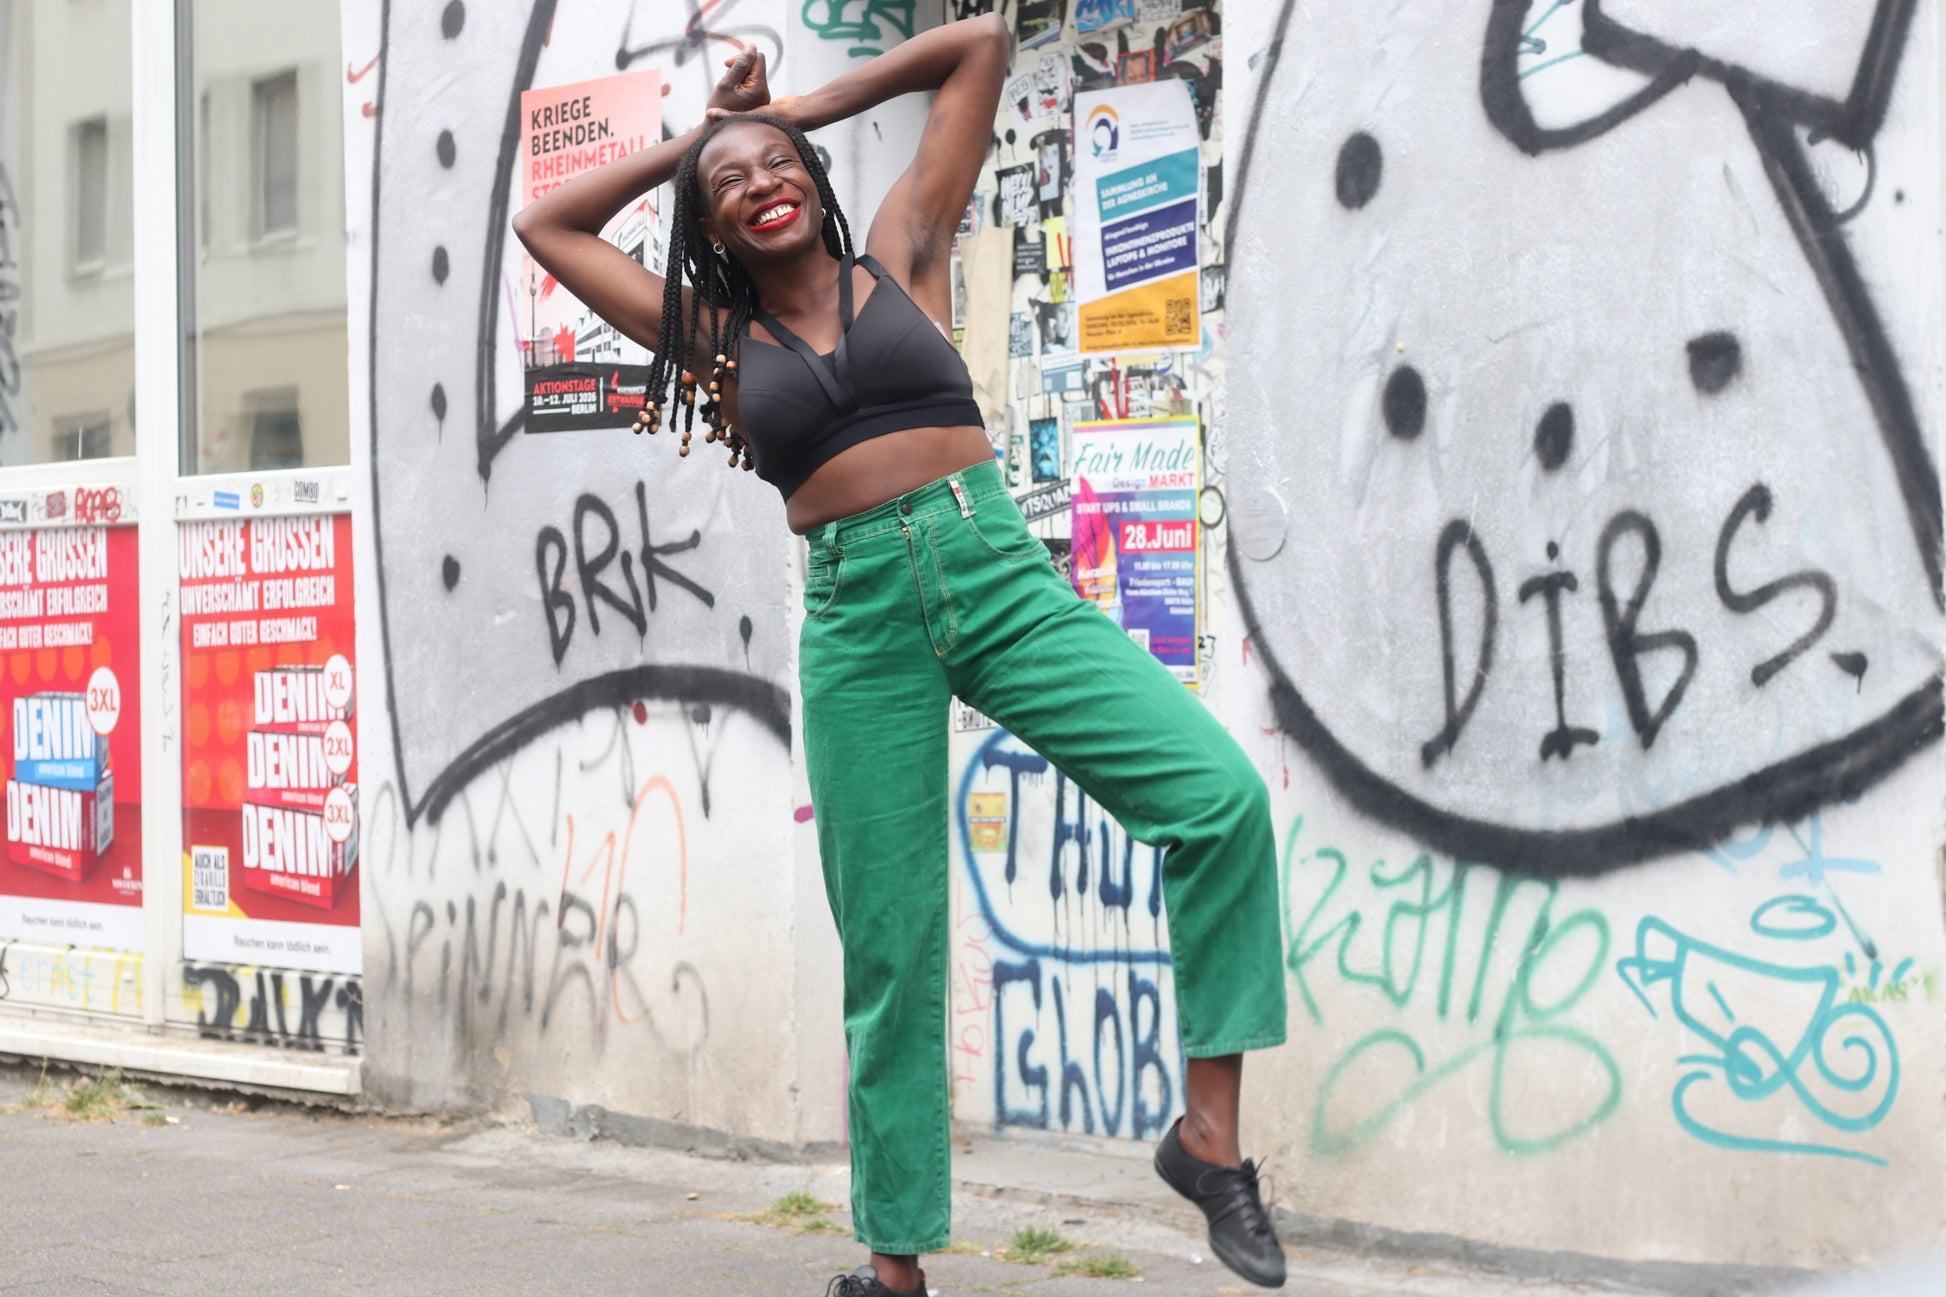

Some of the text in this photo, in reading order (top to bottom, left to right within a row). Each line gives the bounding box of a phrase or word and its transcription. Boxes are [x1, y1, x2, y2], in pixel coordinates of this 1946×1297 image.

[531, 96, 592, 131] KRIEGE
[532, 117, 615, 156] BEENDEN.
[1101, 173, 1158, 199] SAMMLUNG AN
[1106, 250, 1138, 269] LAPTOPS
[1139, 248, 1146, 259] &
[533, 378, 597, 395] AKTIONSTAGE
[562, 393, 578, 405] JULI
[571, 403, 597, 415] BERLIN
[1073, 439, 1195, 475] Fair Made
[1112, 472, 1195, 489] Design MARKT
[1076, 502, 1101, 515] START
[1103, 502, 1120, 513] UPS
[1121, 501, 1128, 513] &
[1129, 501, 1156, 512] SMALL
[1158, 500, 1191, 511] BRANDS
[178, 519, 246, 579] UNSERE
[1124, 522, 1192, 550] 28.Juni
[0, 529, 32, 585] SERE
[46, 584, 108, 616] ERFOLGREICH
[180, 575, 335, 615] UNVERSCHÄMT ERFOLGREICH
[18, 625, 42, 649] GUTER
[43, 621, 93, 648] GESCHMACK!
[193, 616, 317, 648] EINFACH GUTER GESCHMACK!
[329, 671, 345, 690] XL
[90, 687, 116, 712] 3XL
[14, 697, 96, 761] DENIM
[247, 732, 333, 789] DENIM
[327, 737, 350, 756] 2XL
[7, 779, 82, 851] DENIM
[327, 804, 350, 823] 3XL
[242, 802, 333, 878] DENIM
[233, 934, 331, 954] Rauchen kann tödlich sein.
